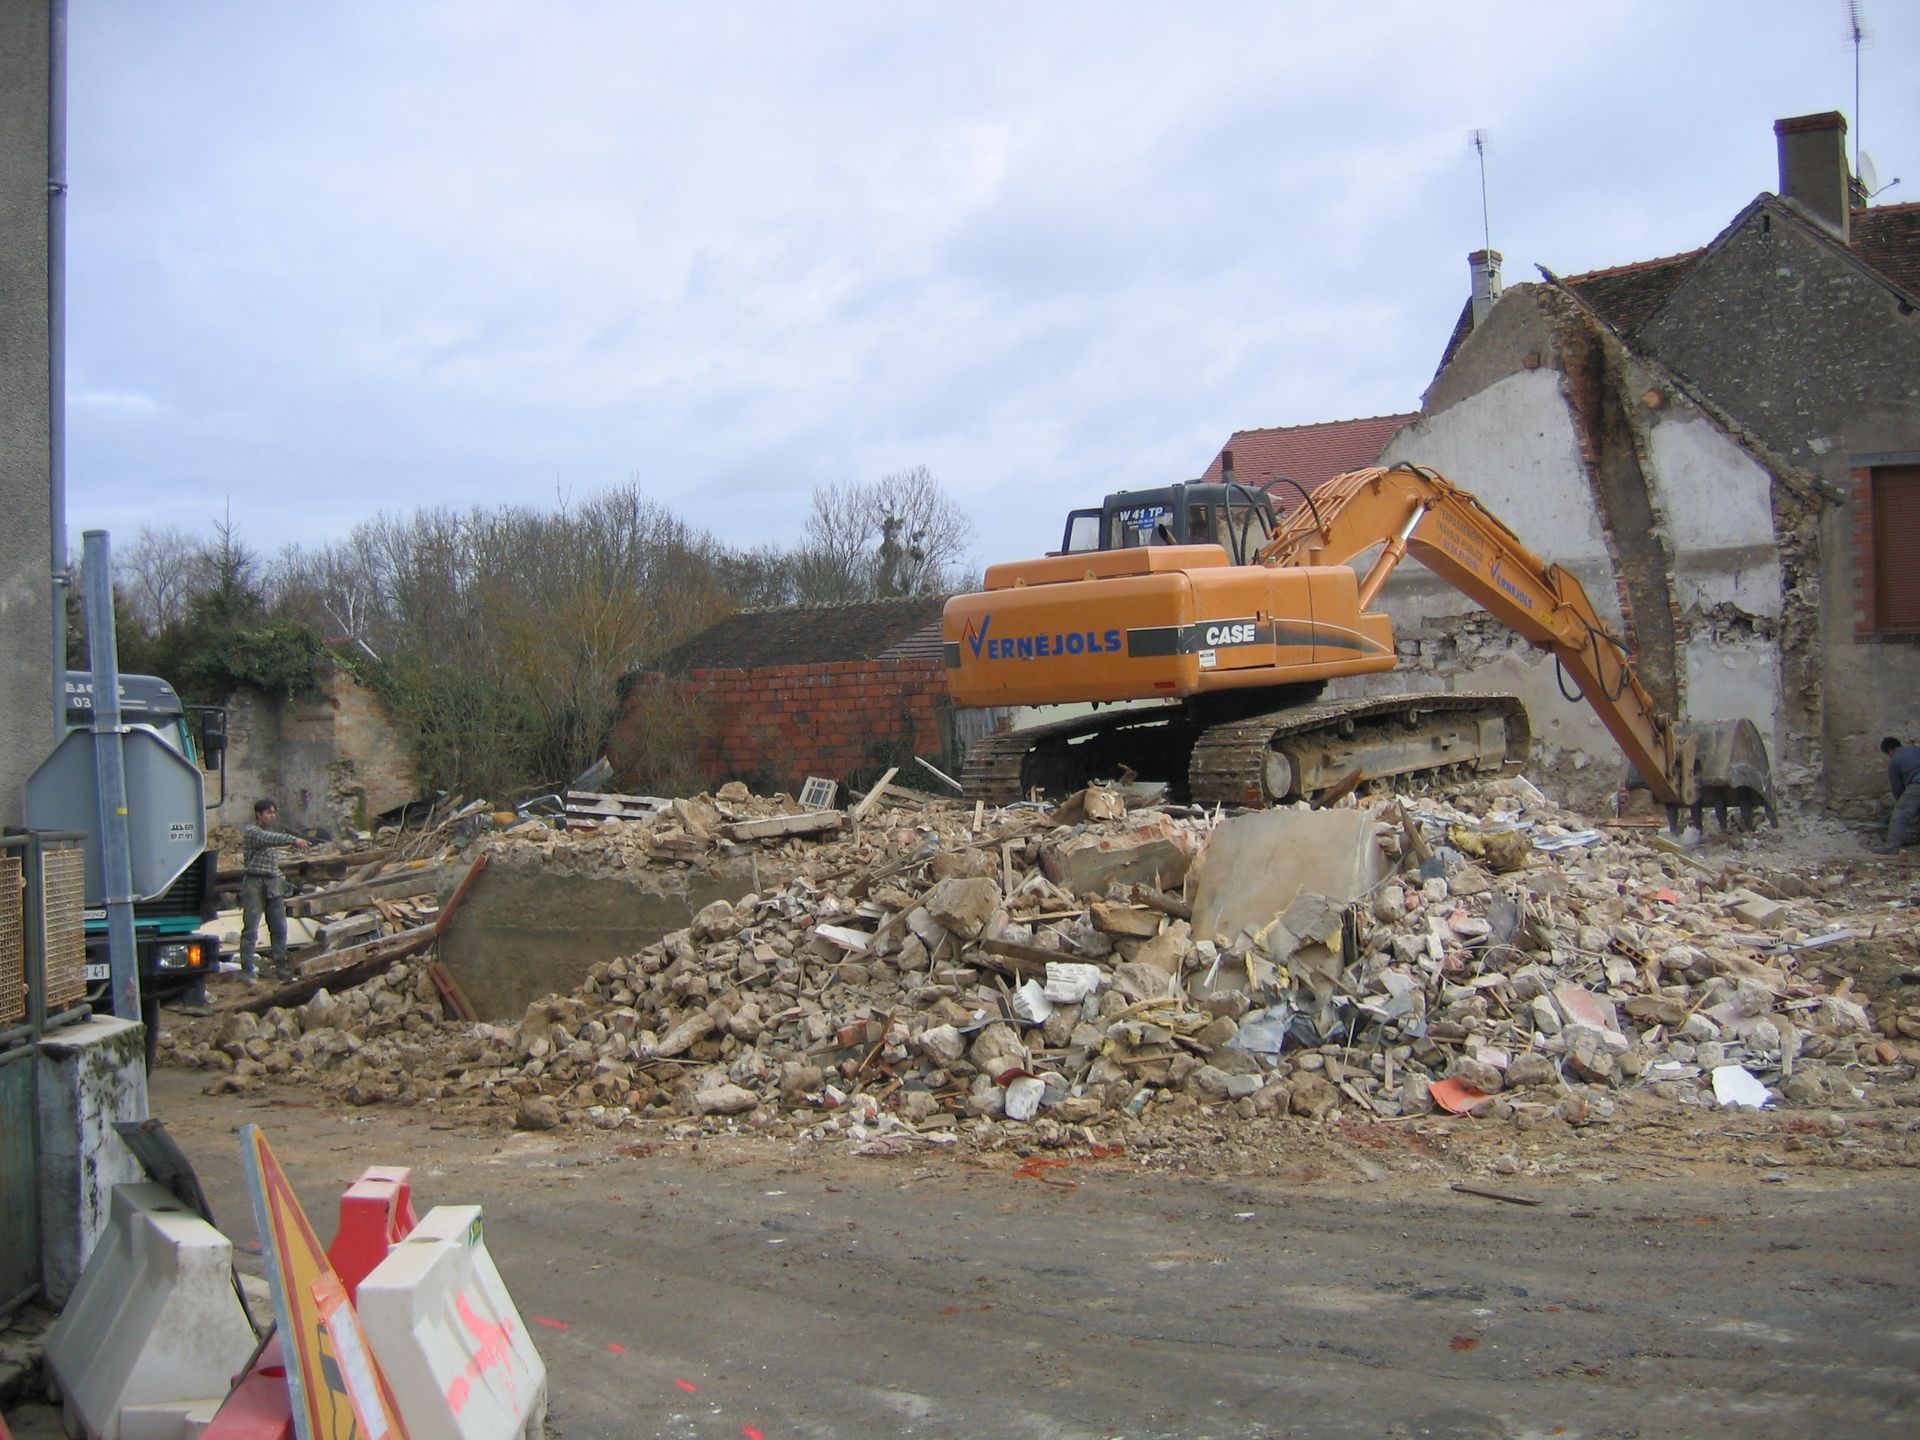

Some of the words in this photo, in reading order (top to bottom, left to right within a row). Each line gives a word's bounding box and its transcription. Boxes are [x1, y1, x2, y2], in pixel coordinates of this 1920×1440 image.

[1120, 511, 1131, 521] W
[1132, 509, 1145, 519] 41
[1149, 506, 1163, 517] TP
[968, 614, 1122, 660] VERNEJOLS
[1206, 624, 1255, 645] CASE
